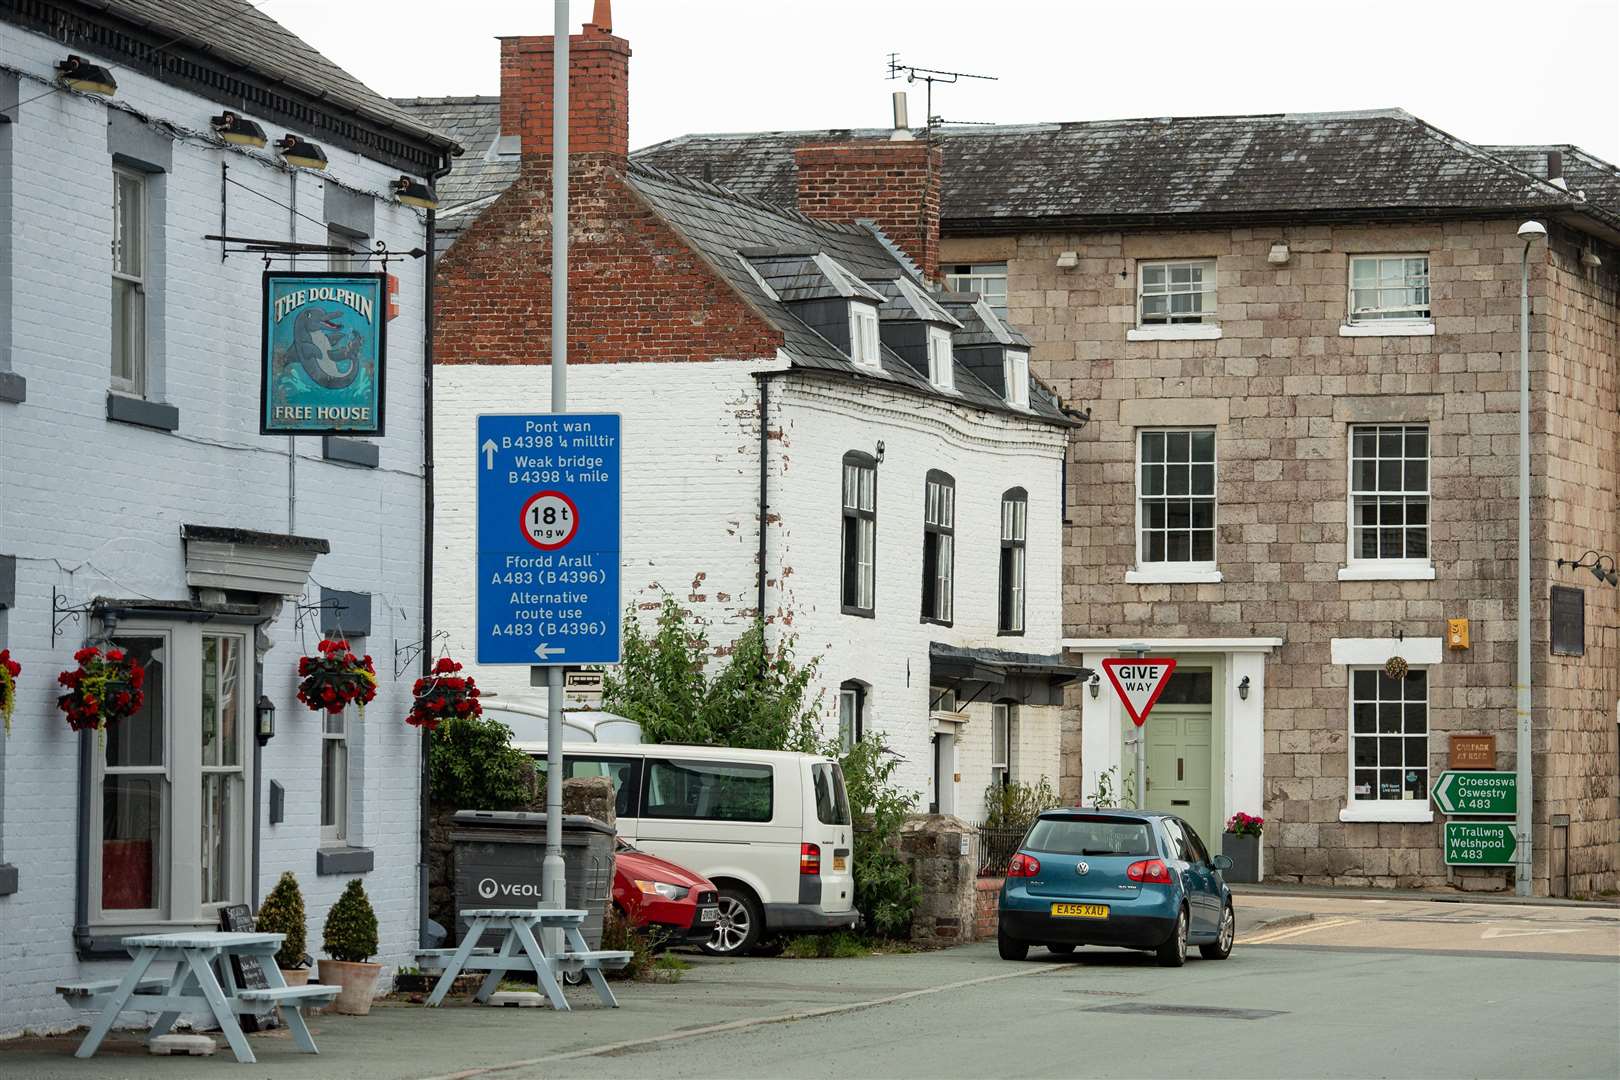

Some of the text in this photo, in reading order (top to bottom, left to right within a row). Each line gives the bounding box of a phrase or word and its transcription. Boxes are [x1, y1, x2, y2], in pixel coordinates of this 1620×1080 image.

[274, 287, 374, 325] THE DOLPHIN
[275, 406, 370, 420] FREE HOUSE
[526, 421, 591, 433] Pont wan
[573, 434, 615, 447] milltir
[515, 455, 603, 469] Weak bridge
[580, 470, 609, 483] mile
[506, 555, 593, 568] Ffordd Arall
[510, 591, 588, 604] Alternative
[515, 607, 583, 620] route use
[1119, 666, 1159, 679] GIVE
[1125, 682, 1152, 692] WAY
[1458, 787, 1507, 800] Oswestry
[1450, 827, 1504, 839] Y Trallwng
[1450, 838, 1505, 850] Welshpool
[1057, 904, 1104, 916] EA55 XAU
